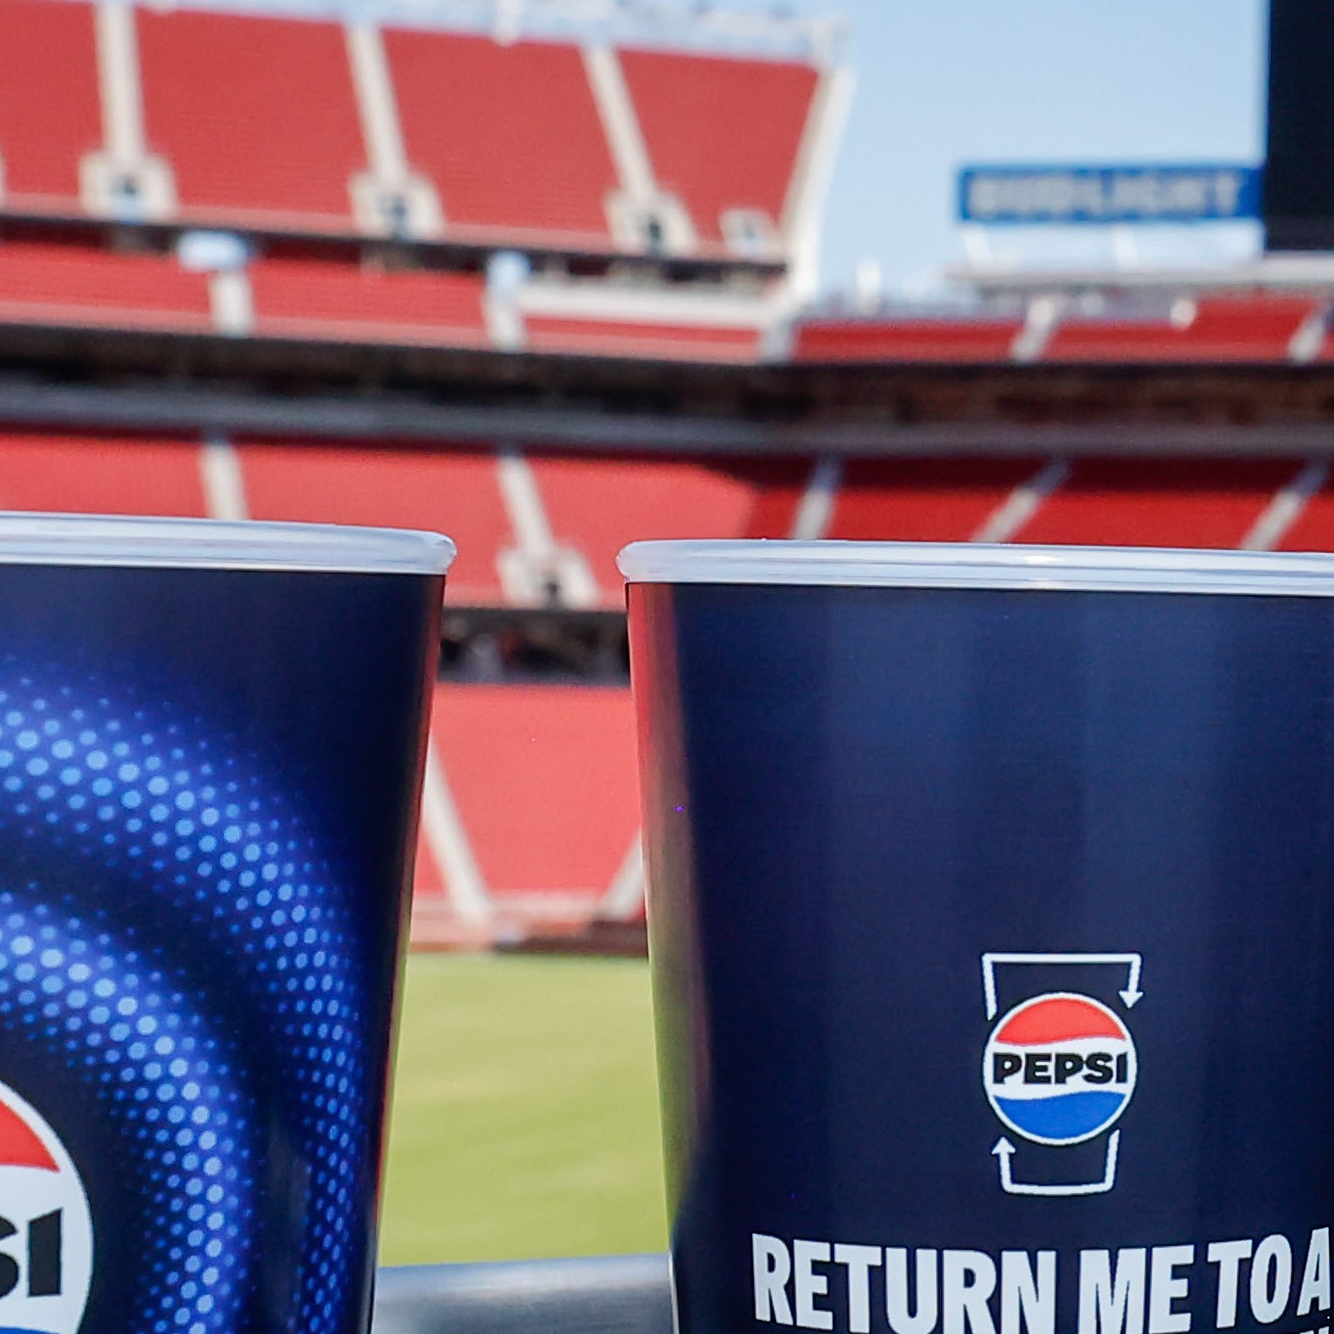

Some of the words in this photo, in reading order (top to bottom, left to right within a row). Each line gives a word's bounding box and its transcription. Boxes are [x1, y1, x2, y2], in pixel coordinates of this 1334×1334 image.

[992, 1051, 1128, 1085] PEPSI
[1207, 1234, 1292, 1329] TO
[1296, 1226, 1331, 1316] A
